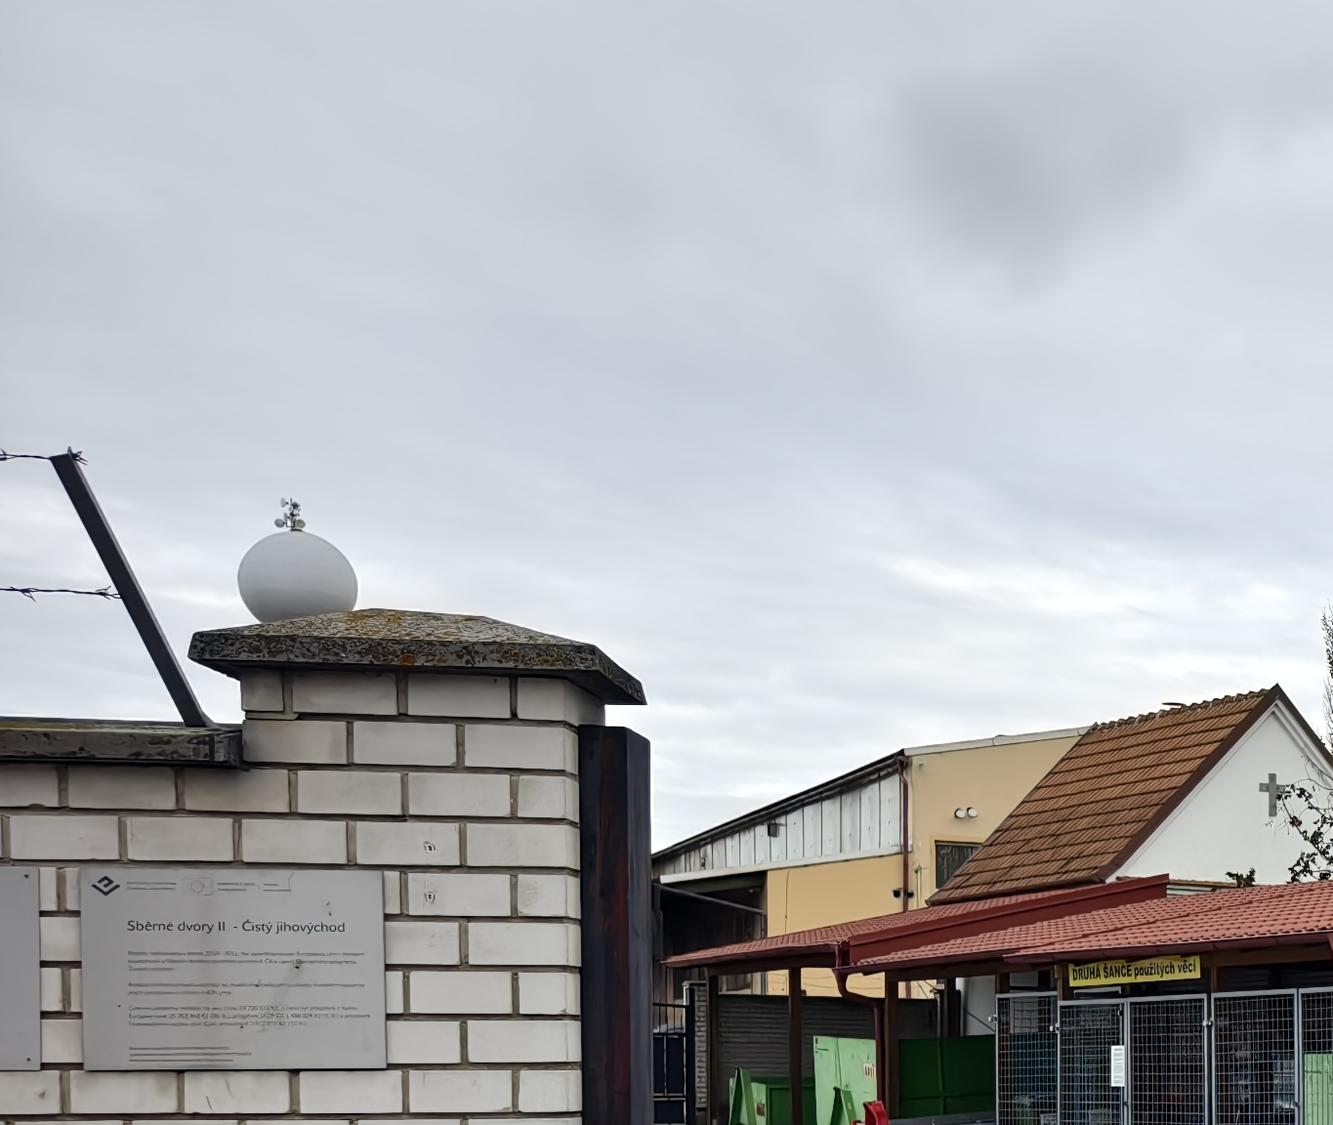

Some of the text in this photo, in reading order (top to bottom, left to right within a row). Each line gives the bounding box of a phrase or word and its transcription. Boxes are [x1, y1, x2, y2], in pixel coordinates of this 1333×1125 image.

[126, 919, 174, 933] Sběrné
[177, 920, 215, 935] dvory
[241, 918, 273, 935] Čistý
[275, 920, 346, 935] jihovýchod
[1072, 965, 1101, 981] DRUHÁ
[1103, 963, 1132, 979] ŠANCE
[1134, 961, 1175, 980] použitých
